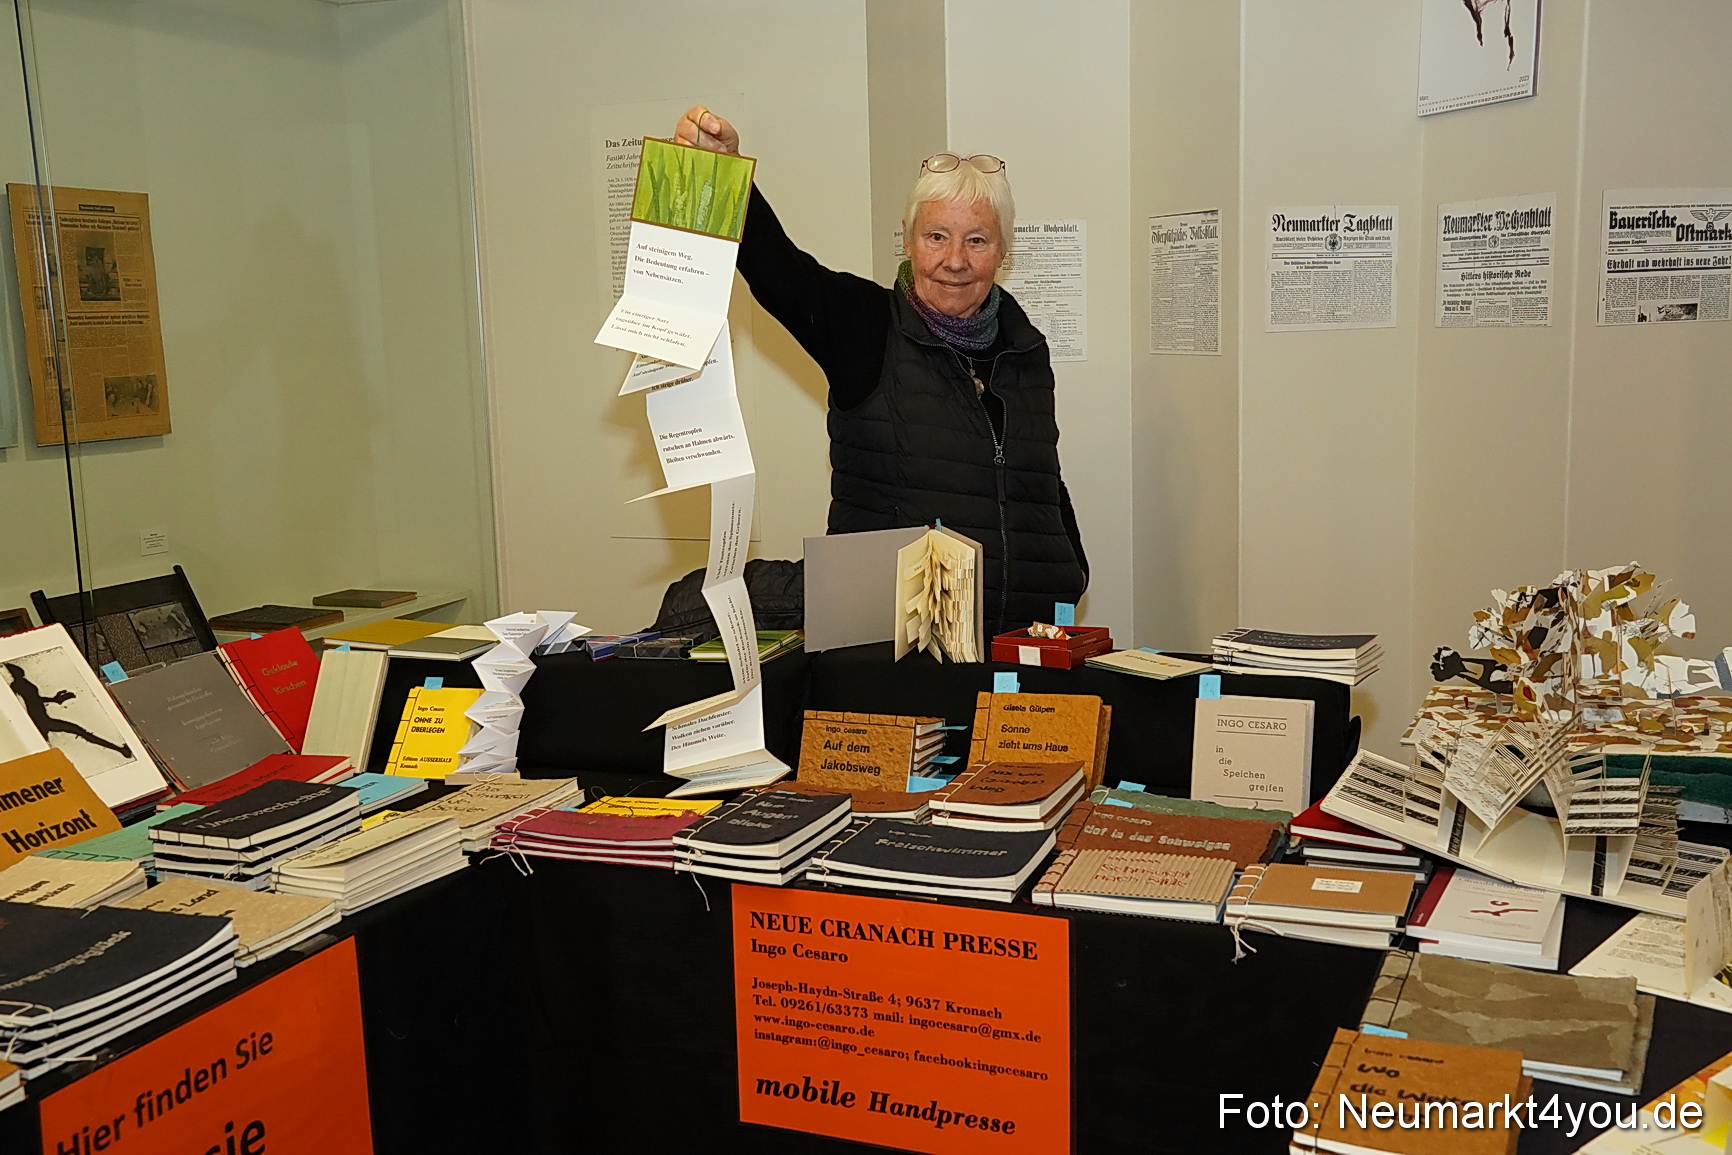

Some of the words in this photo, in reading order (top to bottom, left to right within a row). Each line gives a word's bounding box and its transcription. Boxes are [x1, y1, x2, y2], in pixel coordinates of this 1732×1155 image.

[605, 139, 620, 148] Das
[621, 138, 642, 147] Zeitu
[1271, 213, 1340, 233] Neumarkter
[1343, 213, 1393, 235] Tagblatt
[1442, 212, 1494, 234] Neumarkter
[1494, 206, 1551, 232] Wochenblatt
[1609, 210, 1677, 230] Bayerische
[1675, 222, 1732, 242] Ostmark
[649, 245, 676, 256] steinigem
[678, 252, 693, 260] Weg.
[646, 258, 677, 271] Bedeutung
[678, 265, 705, 276] erfahren
[1607, 258, 1635, 269] Ehrhaft
[1637, 258, 1649, 268] und
[1651, 256, 1682, 268] wehrhaft
[1683, 256, 1694, 266] ins
[1695, 257, 1711, 266] neue
[1712, 255, 1732, 267] Jahr!
[645, 270, 684, 284] Nebensätzen.
[1460, 271, 1481, 281] Hitlers
[1482, 269, 1514, 281] historische
[1514, 269, 1532, 279] Rede
[632, 312, 655, 321] einziger
[651, 325, 667, 333] Kopf
[668, 428, 702, 439] Regentropfen
[662, 444, 684, 452] rutschen
[666, 456, 685, 464] Bleiben
[685, 449, 722, 460] verschwunden.
[261, 660, 298, 676] Geklaute
[273, 680, 307, 695] Kirschen
[1003, 704, 1026, 712] Gisela
[1029, 705, 1055, 714] Gülpen
[413, 716, 433, 724] OHNE
[671, 720, 697, 732] Schmales
[698, 710, 732, 724] Dachfenster.
[1217, 719, 1244, 728] INGO
[1248, 721, 1287, 731] CESARO
[671, 731, 692, 740] Wolken
[693, 726, 711, 735] ziehen
[711, 719, 736, 729] vorüber.
[1001, 724, 1031, 734] Sonne
[682, 737, 707, 748] Himmels
[708, 732, 726, 741] Weite.
[823, 739, 844, 751] Auf
[846, 741, 870, 753] dem
[998, 740, 1021, 749] zieht
[1045, 742, 1069, 752] Haus
[1215, 745, 1224, 753] in
[820, 758, 881, 777] Jakobsweg
[1218, 757, 1232, 765] die
[1223, 768, 1266, 780] Speichen
[1248, 783, 1284, 793] greifen
[1, 808, 97, 854] Horizont
[1083, 824, 1108, 836] tief
[1110, 829, 1124, 839] in
[1129, 832, 1154, 843] das
[1157, 835, 1231, 851] Schweigen
[874, 838, 1008, 857] Freischwimmer
[178, 888, 220, 907] Land
[750, 911, 813, 935] NEUE
[819, 918, 935, 949] CRANACH
[942, 931, 1039, 961] PRESSE
[750, 938, 787, 959] Ingo
[792, 943, 849, 963] Cesaro
[752, 977, 884, 1004] Joseph-Haydn-Straße
[887, 993, 902, 1008] 4;
[905, 995, 941, 1011] 9637
[945, 1000, 1003, 1020] Kronach
[752, 993, 777, 1007] Tel.
[780, 997, 869, 1019] 09261/63373
[873, 1010, 905, 1024] mail:
[908, 1014, 1042, 1043] ingocesaro@gmx.de
[753, 1014, 875, 1037] www.ingo-cesaro.de
[754, 1028, 910, 1062] instagram:@ingo_cesaro;
[913, 1049, 1049, 1081] facebook:ingocesaro
[57, 1112, 126, 1155] Hier
[133, 1057, 228, 1129] finden
[234, 1028, 275, 1070] Sie
[755, 1075, 857, 1109] mobile
[867, 1090, 1017, 1136] Handpresse
